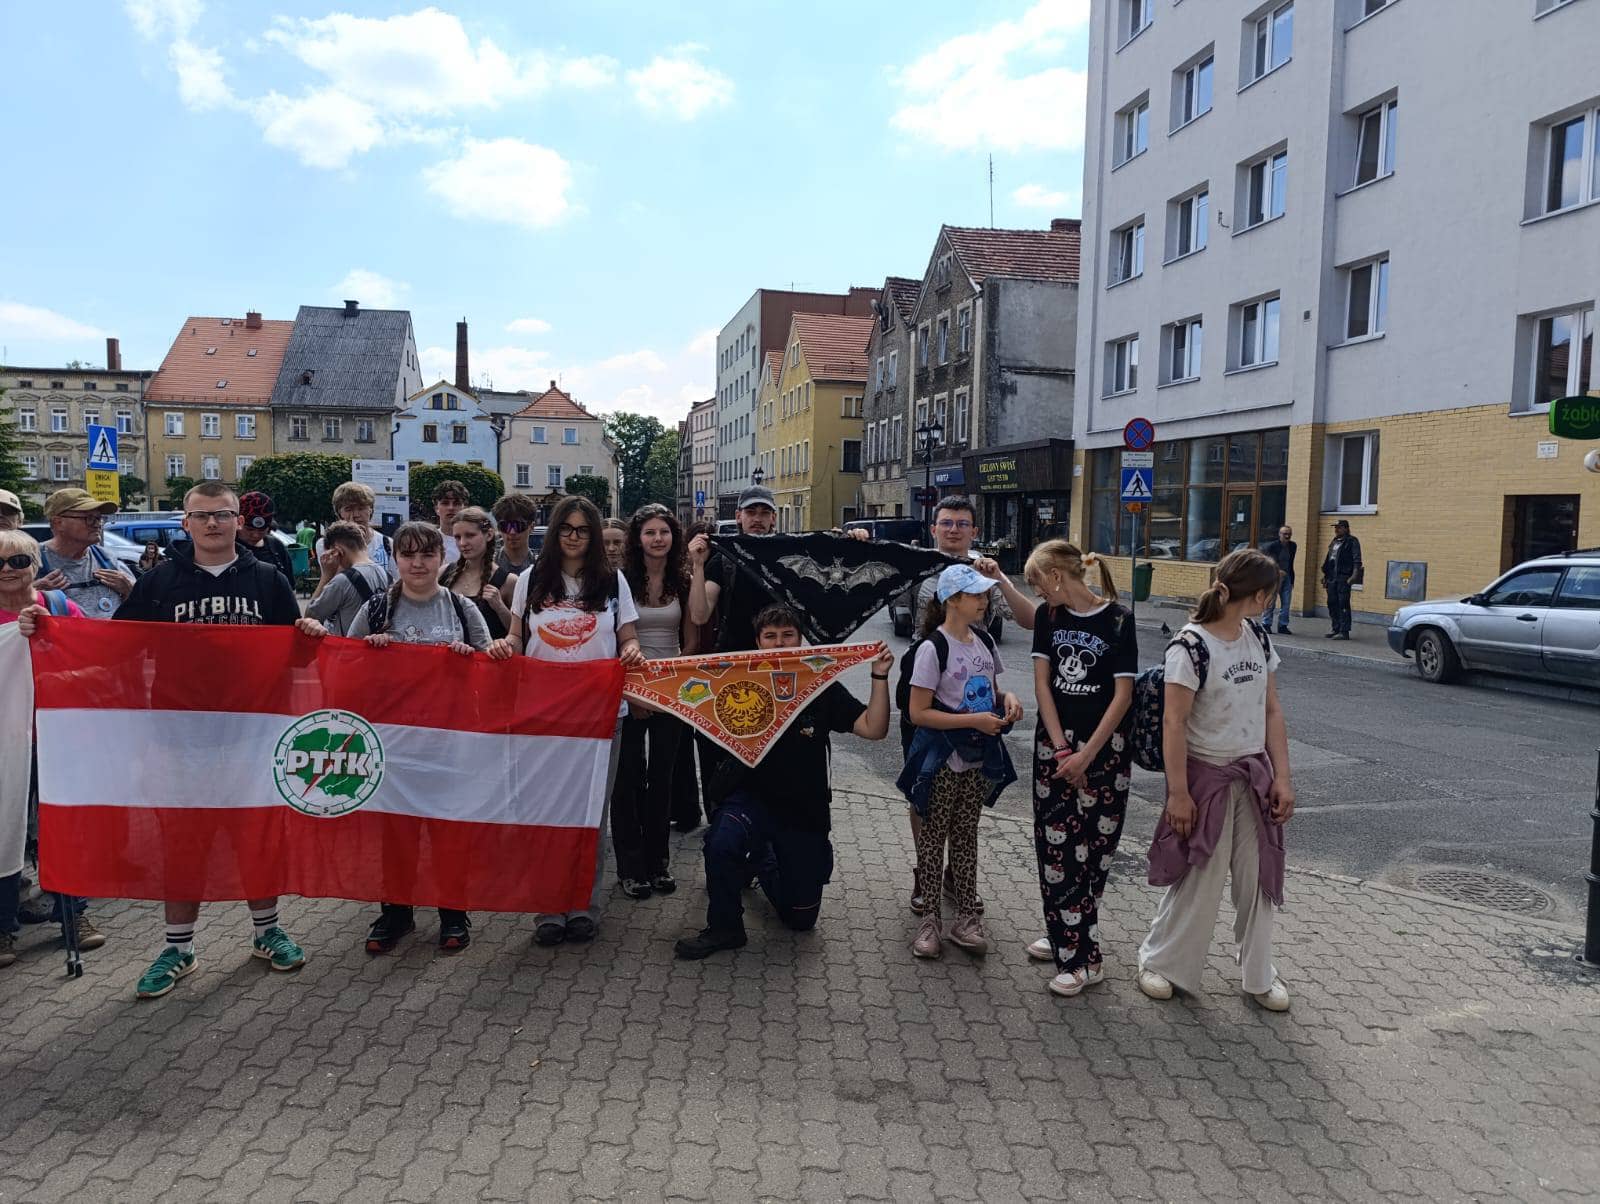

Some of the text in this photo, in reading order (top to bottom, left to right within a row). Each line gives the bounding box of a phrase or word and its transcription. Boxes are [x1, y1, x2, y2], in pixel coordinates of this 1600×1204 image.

[1562, 404, 1600, 422] żabk
[624, 683, 659, 704] AKIEM
[286, 750, 371, 778] PTTK
